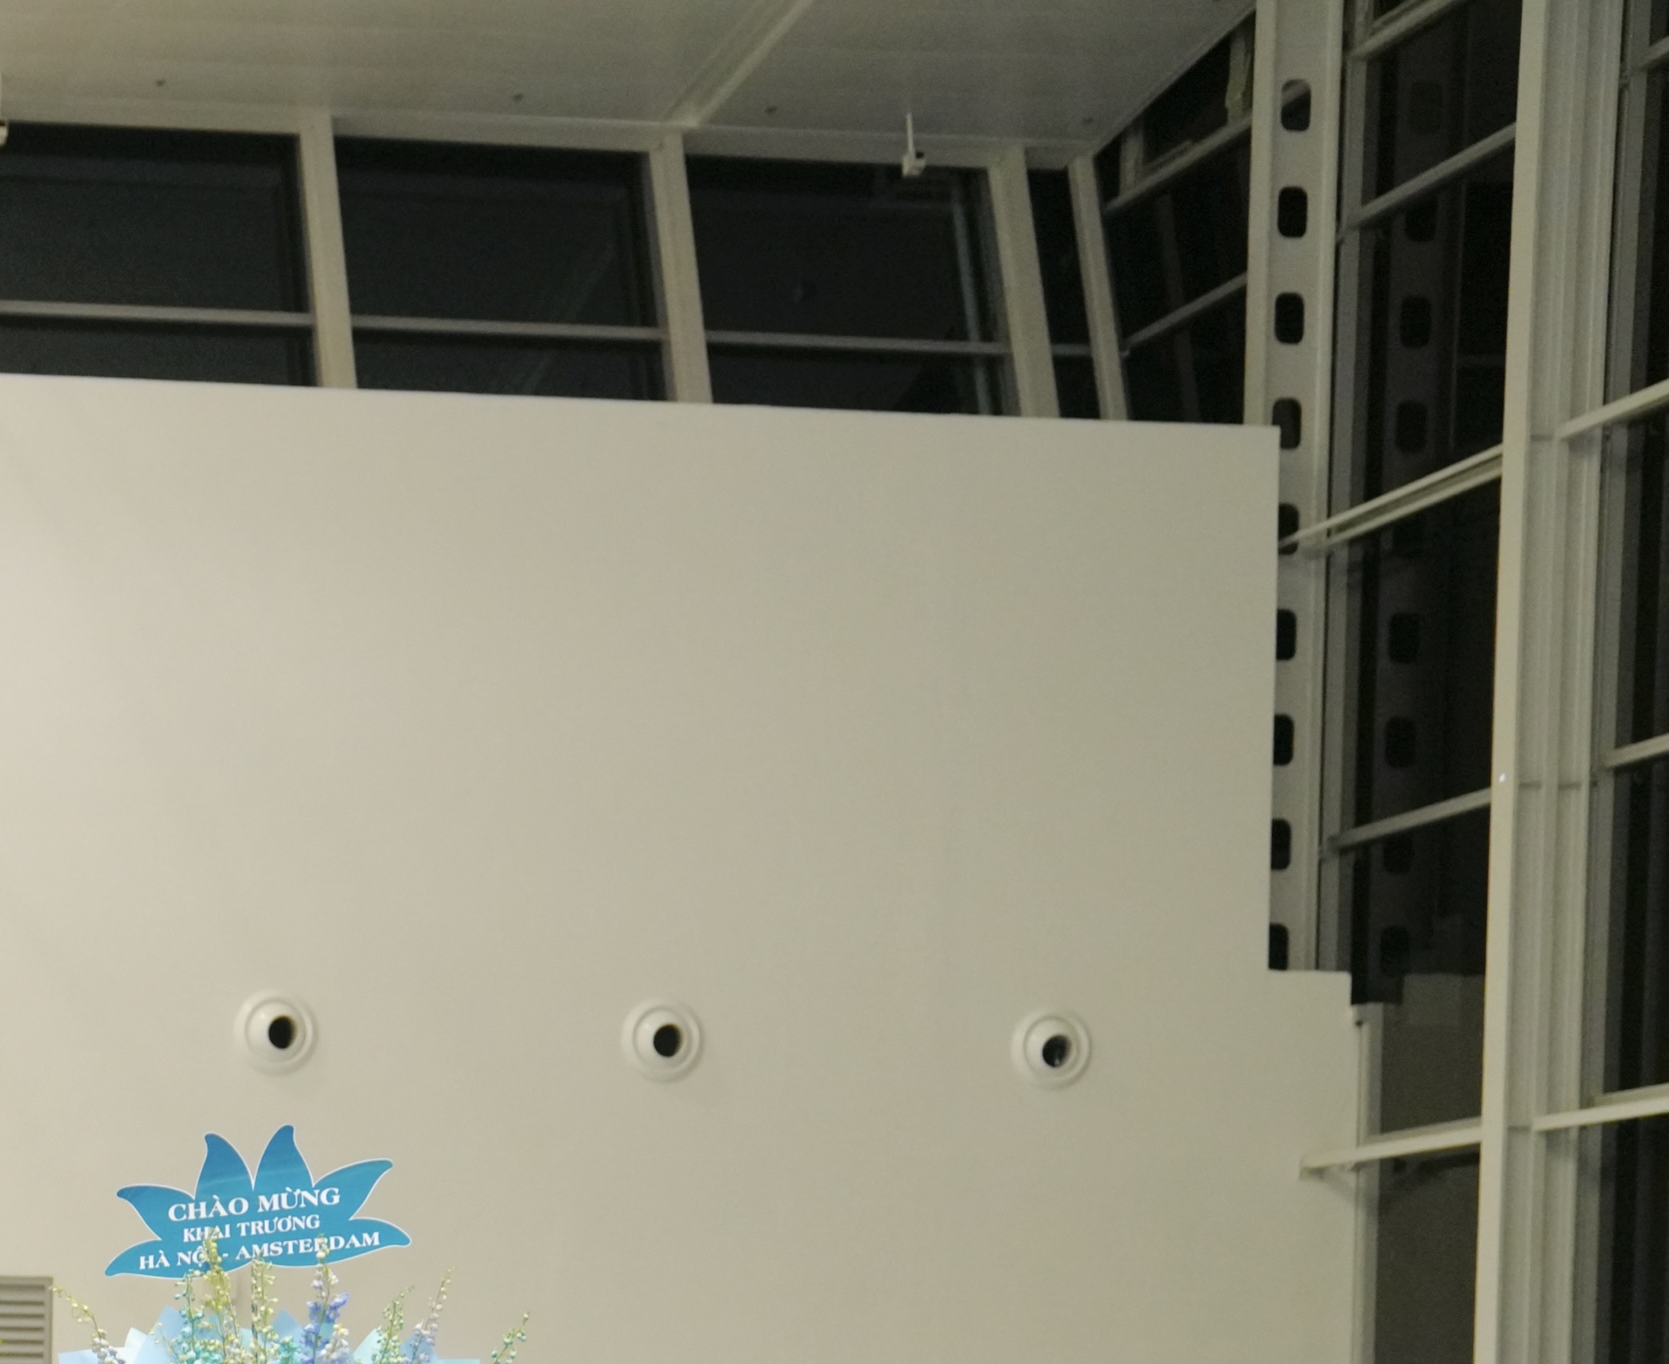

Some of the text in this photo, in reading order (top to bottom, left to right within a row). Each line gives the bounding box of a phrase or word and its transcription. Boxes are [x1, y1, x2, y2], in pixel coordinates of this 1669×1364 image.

[167, 1186, 341, 1222] CHÀO MỪNG
[236, 1214, 321, 1237] TRƯƠNG
[139, 1250, 170, 1270] HÀ
[176, 1246, 213, 1269] NỘ
